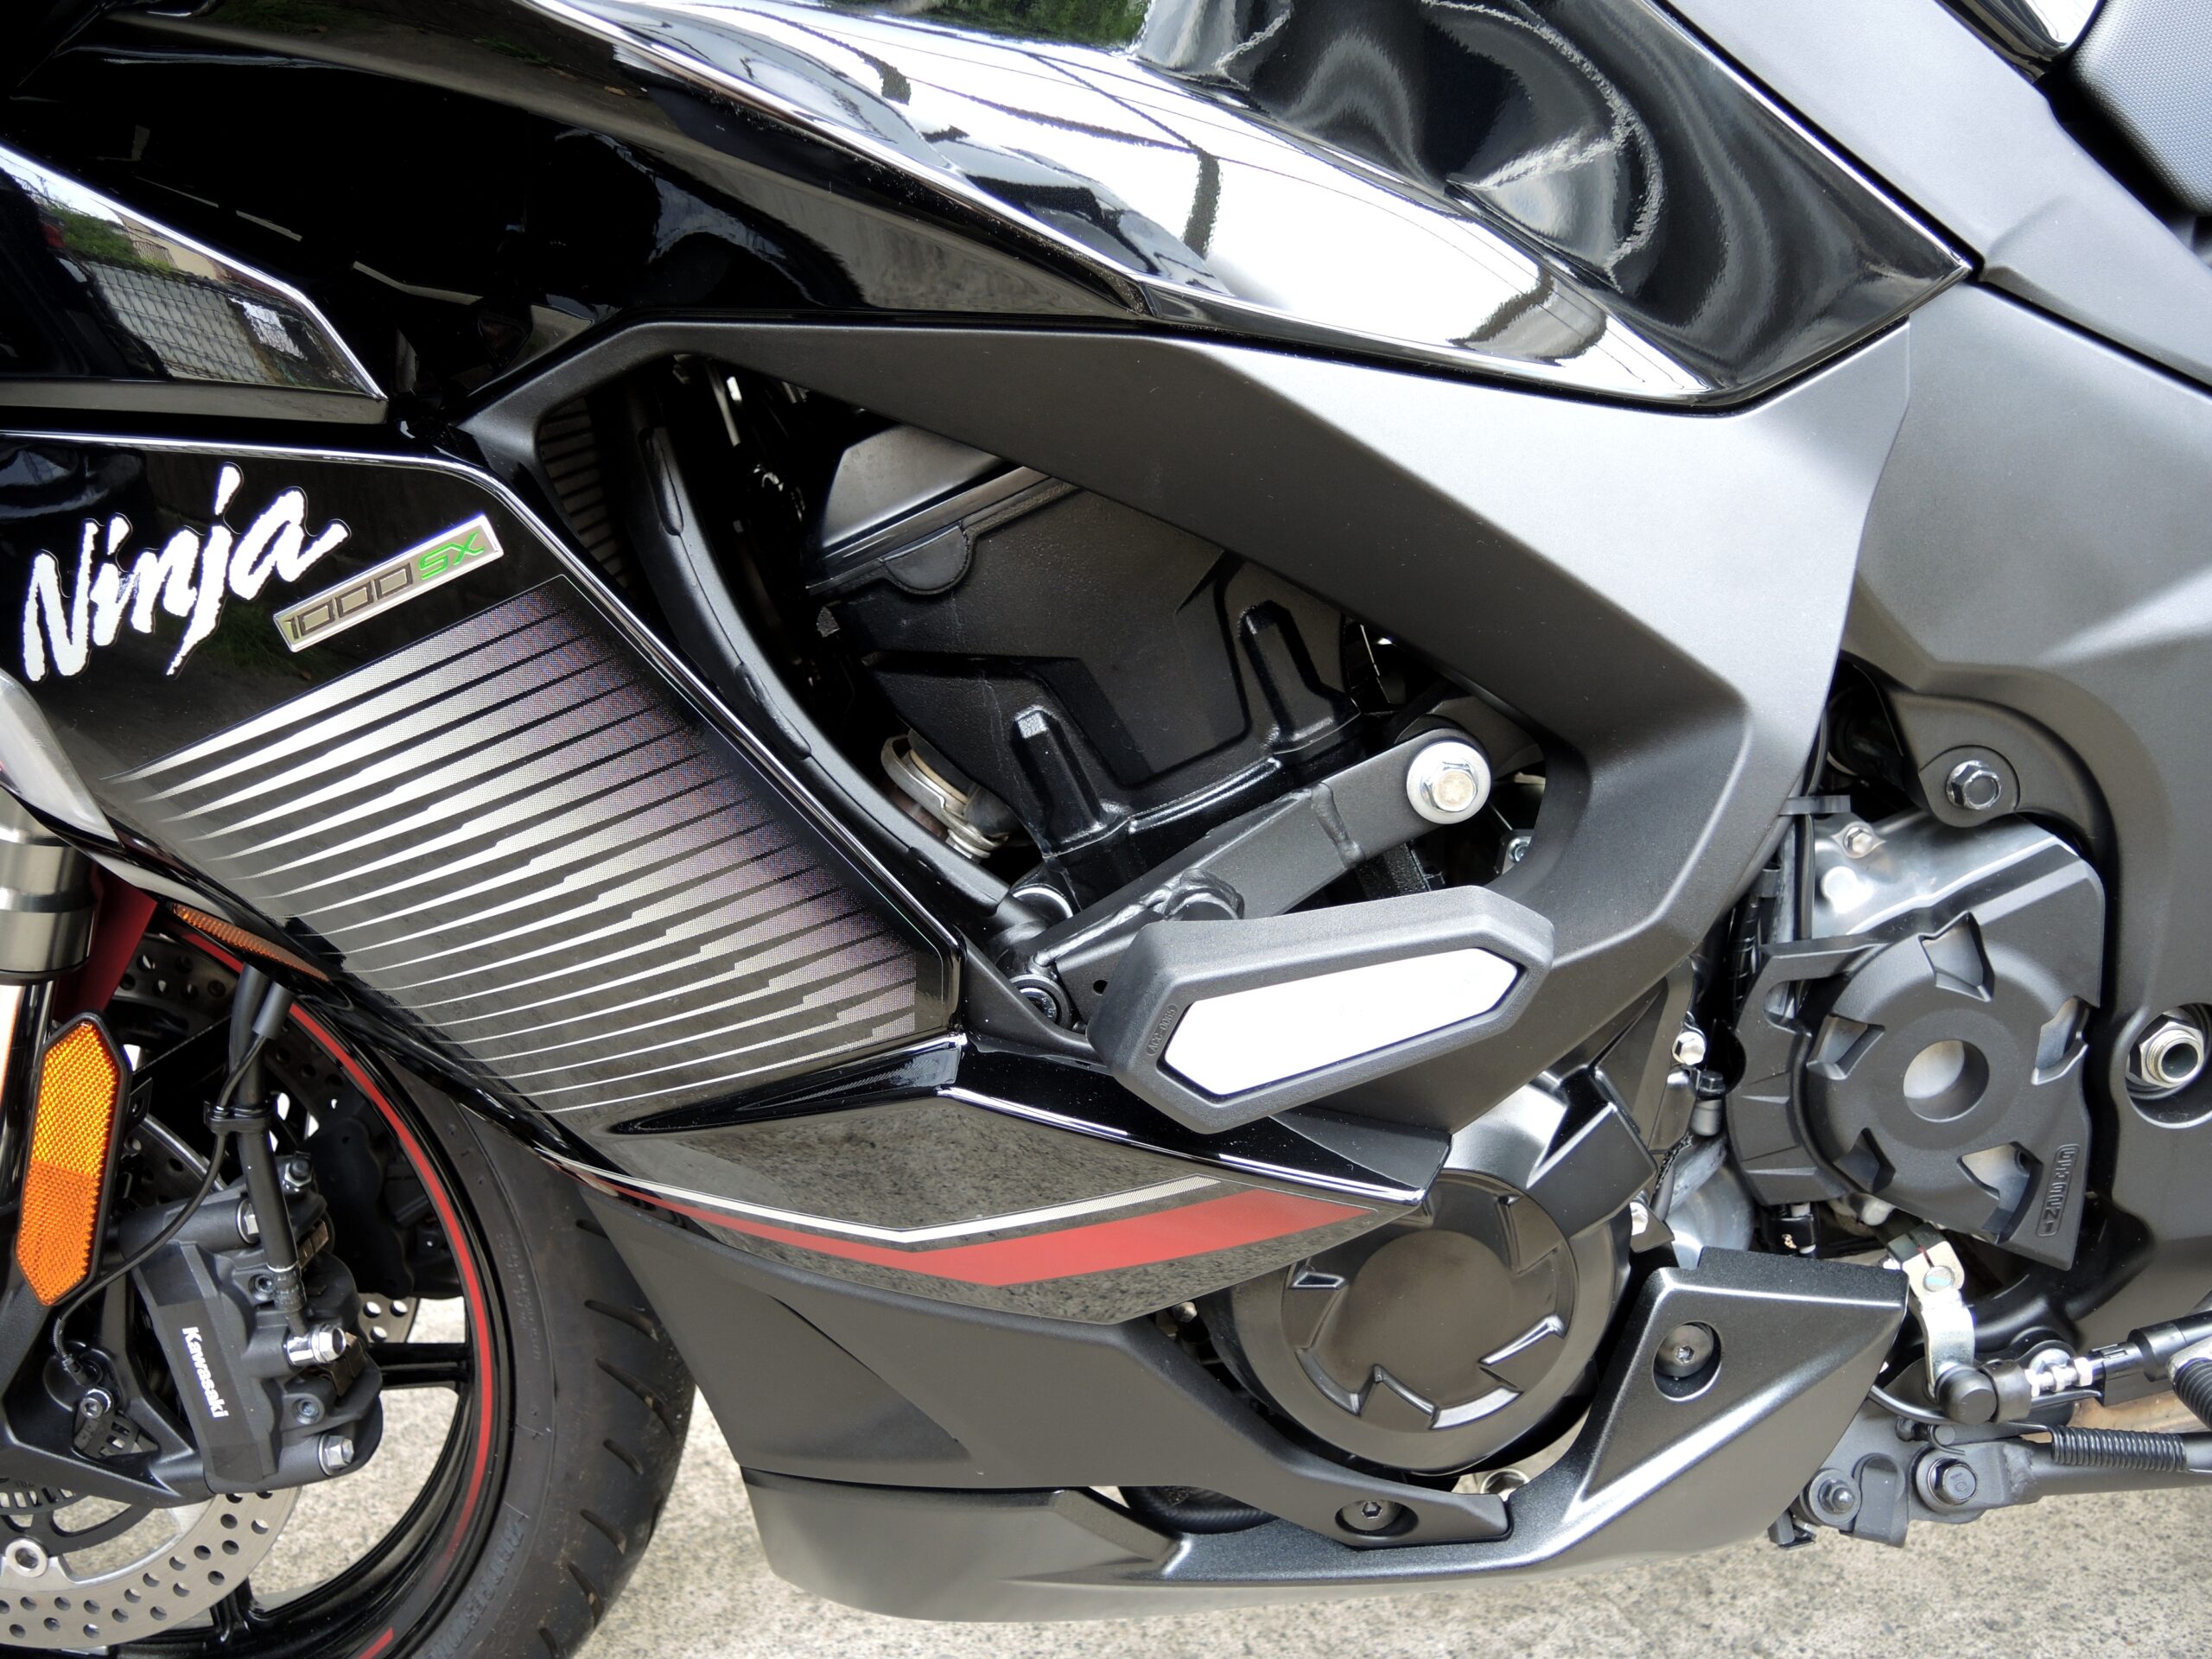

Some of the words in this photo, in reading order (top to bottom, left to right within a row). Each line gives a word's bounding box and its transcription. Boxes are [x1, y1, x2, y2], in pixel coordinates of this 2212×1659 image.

[22, 462, 350, 682] Ninja
[1147, 1007, 1176, 1052] ACC-0065
[181, 1326, 230, 1418] Kawasaki
